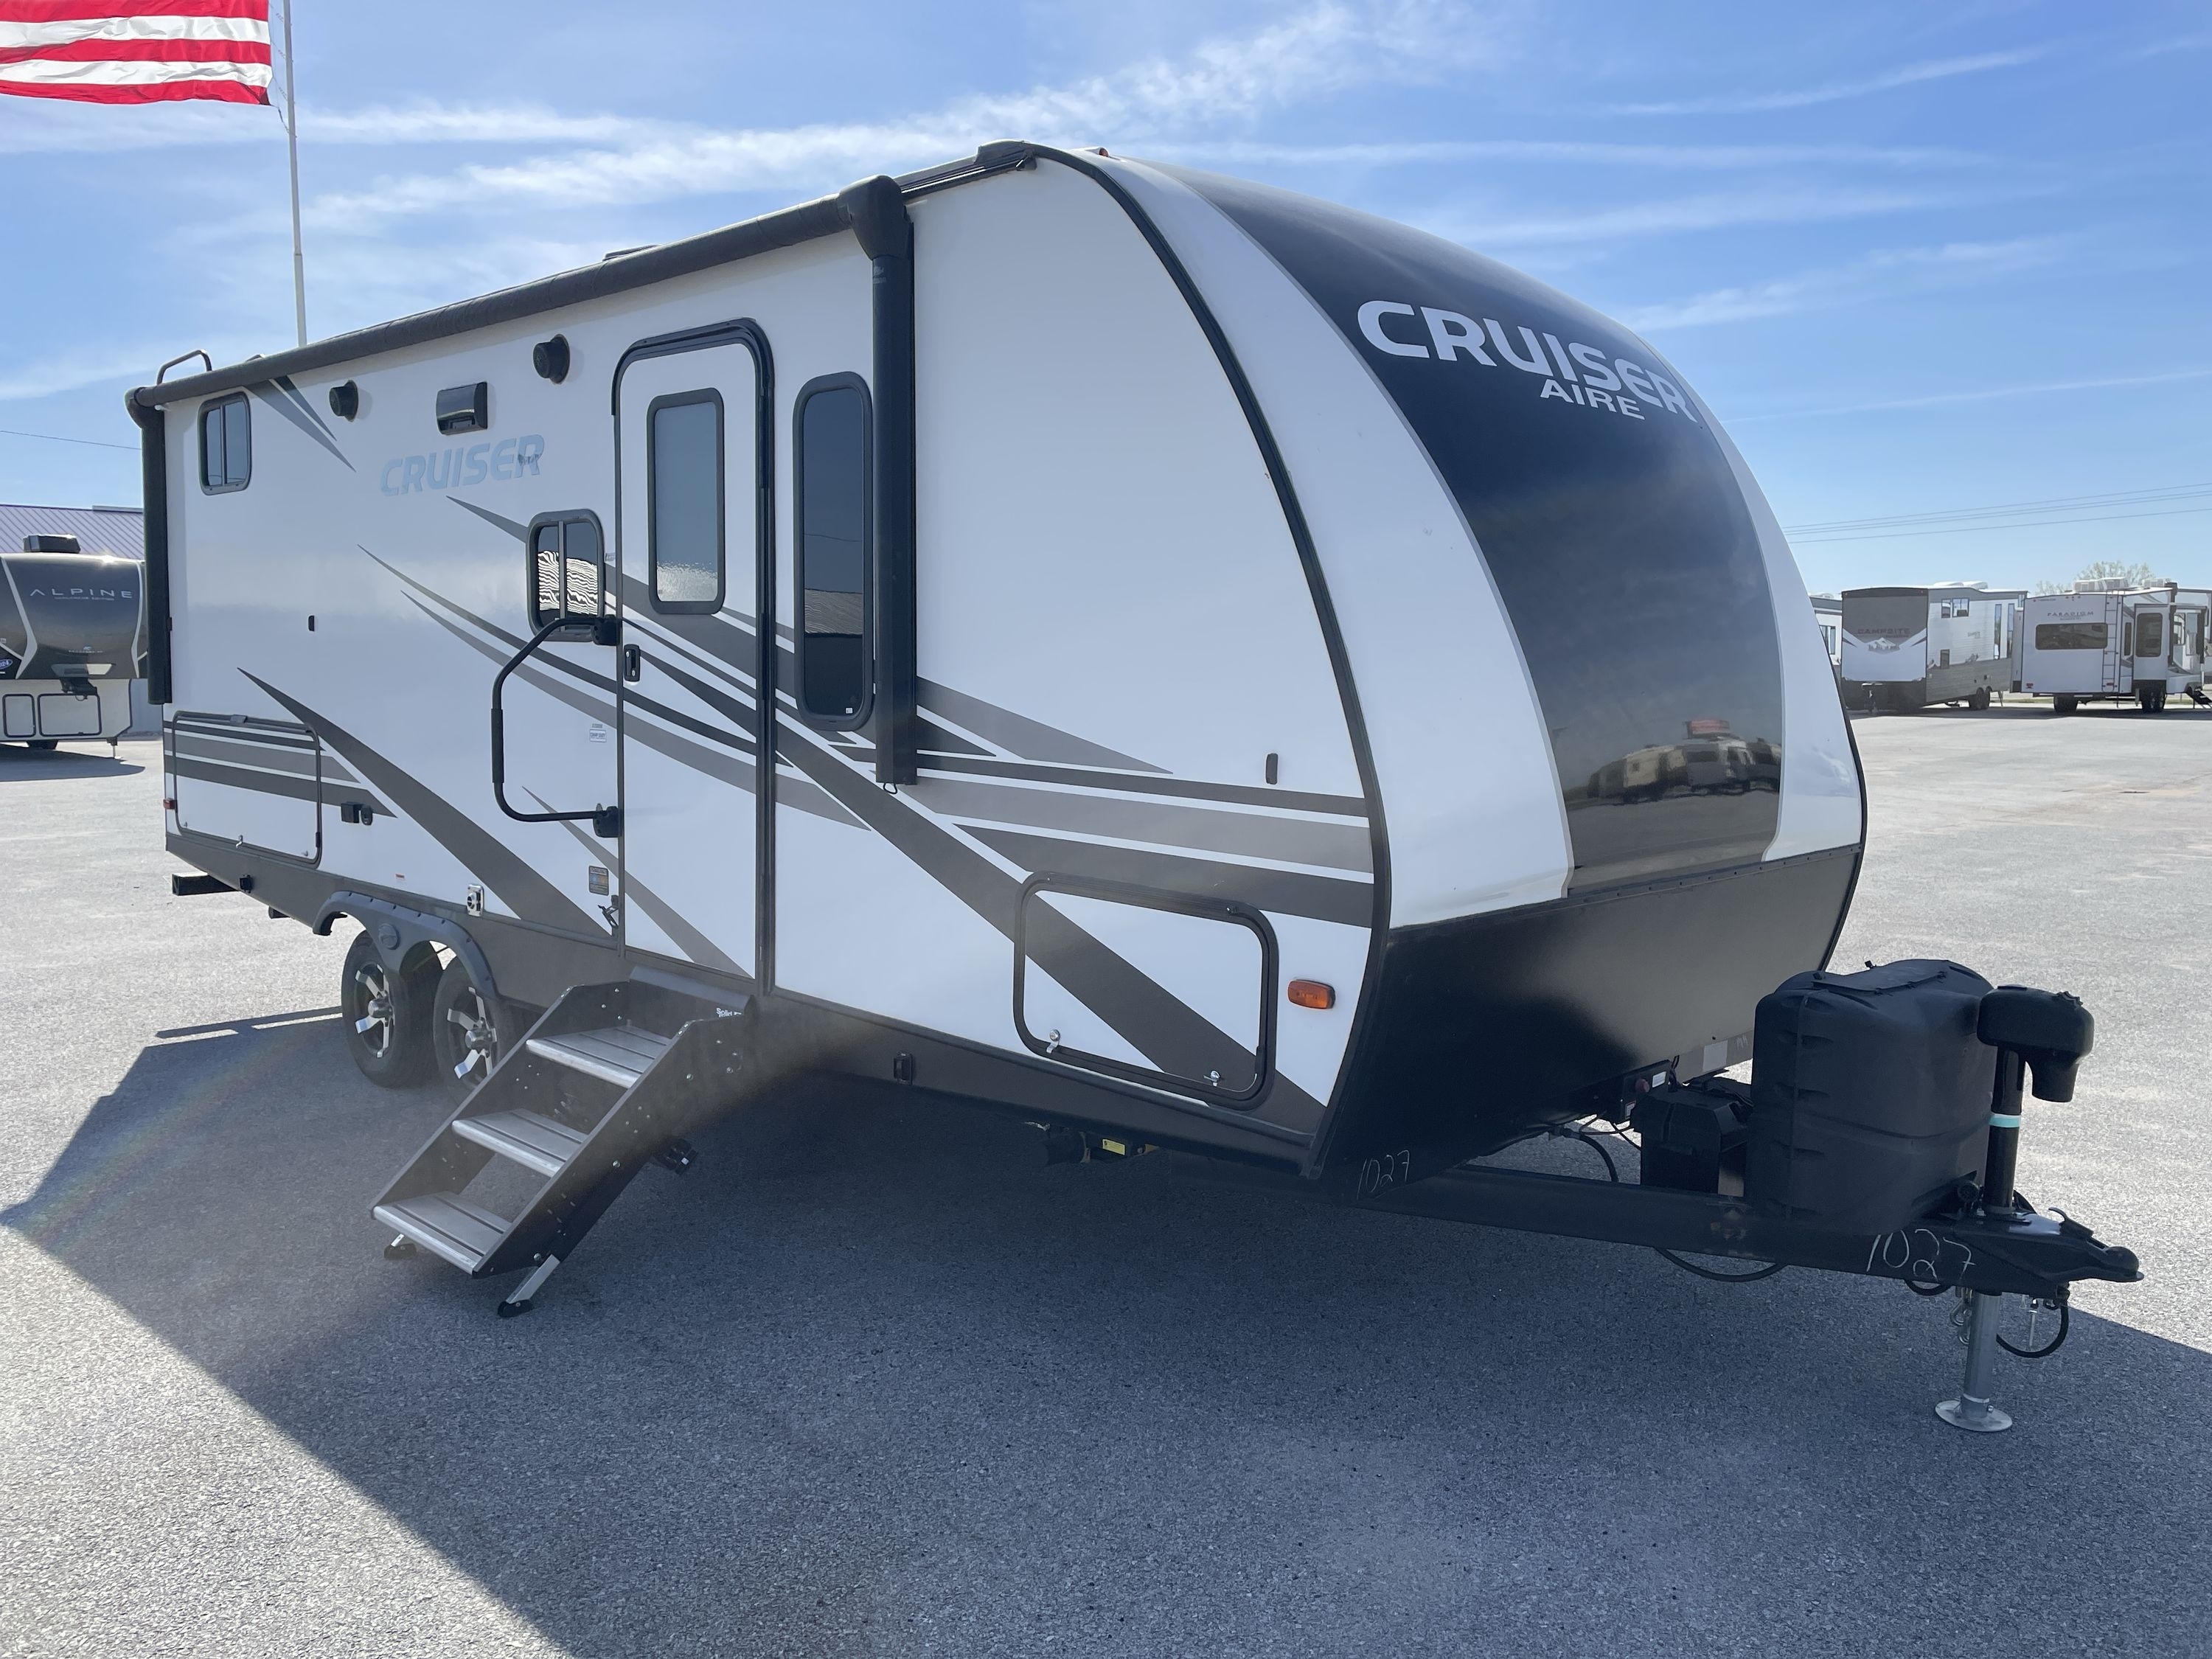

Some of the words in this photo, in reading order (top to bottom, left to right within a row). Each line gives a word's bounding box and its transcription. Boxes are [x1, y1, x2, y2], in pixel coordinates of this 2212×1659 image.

[1357, 300, 1698, 422] CRUISER
[1540, 378, 1645, 420] AIRE
[380, 434, 545, 496] CRUISER
[30, 588, 133, 599] ALPINE
[1357, 1150, 1410, 1200] 1027
[1866, 1228, 1976, 1281] 1027
